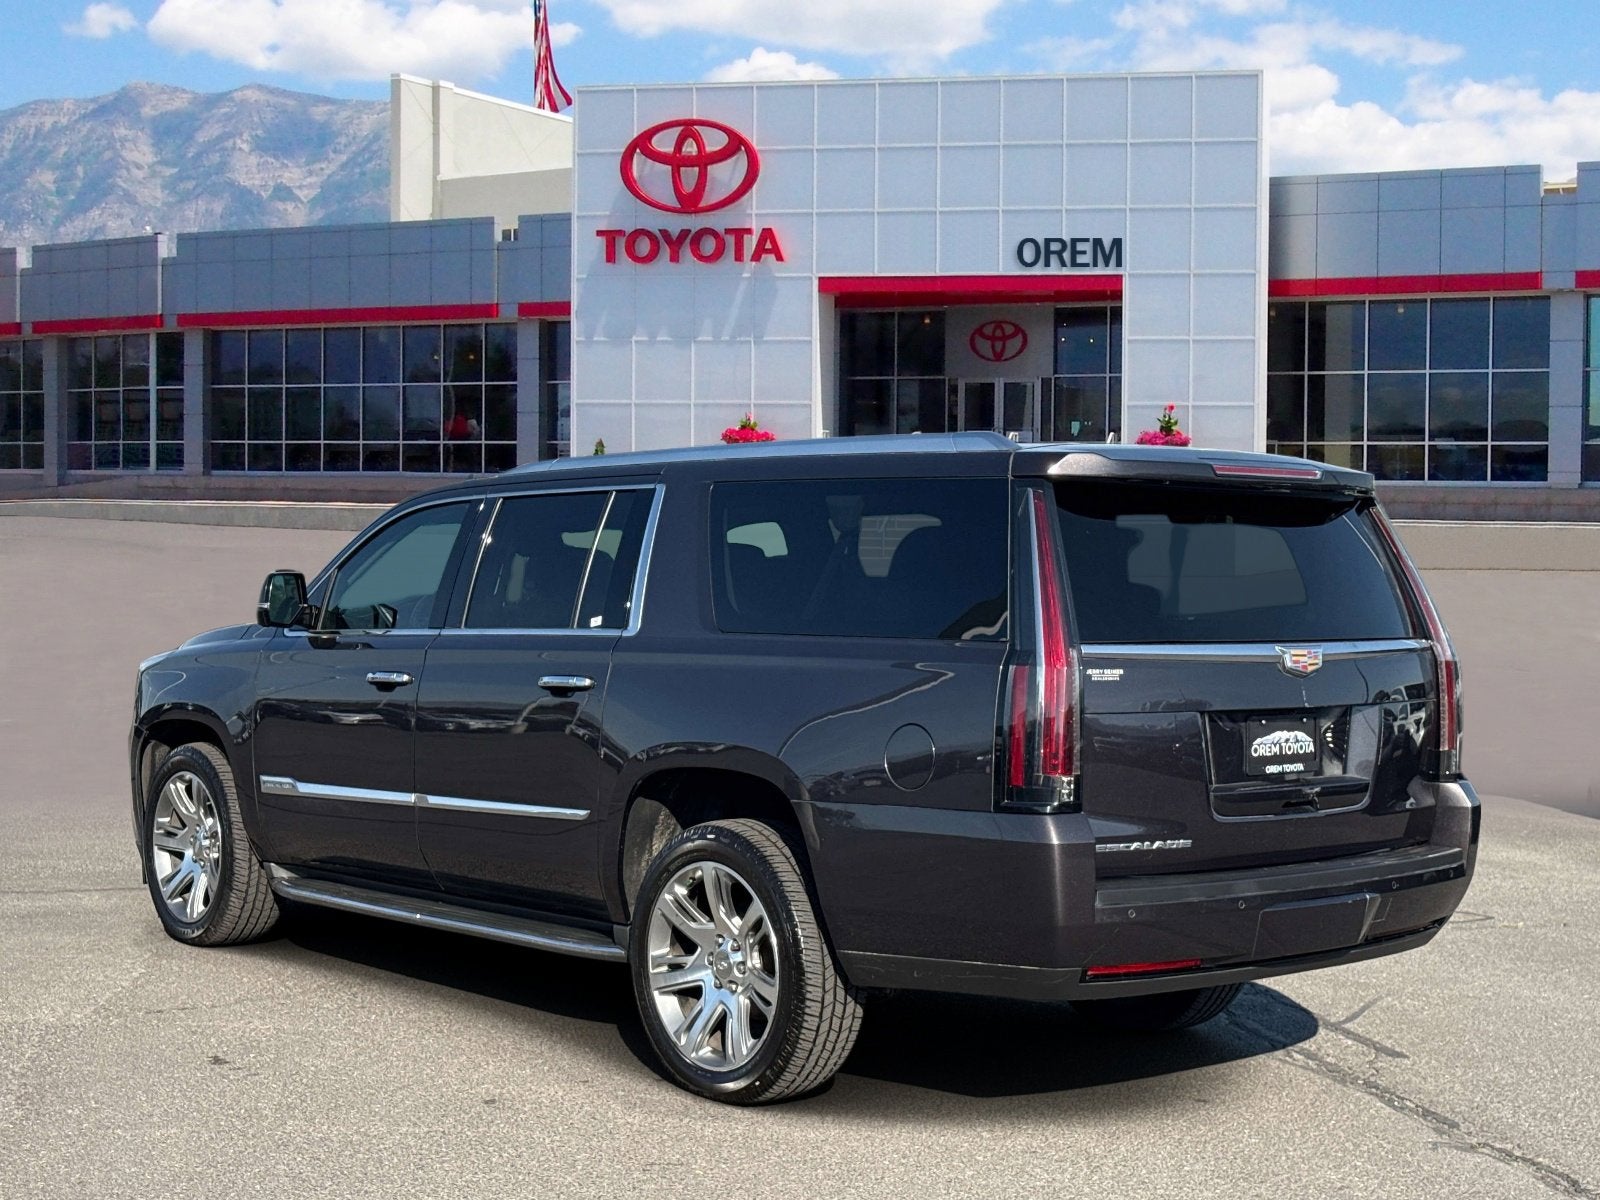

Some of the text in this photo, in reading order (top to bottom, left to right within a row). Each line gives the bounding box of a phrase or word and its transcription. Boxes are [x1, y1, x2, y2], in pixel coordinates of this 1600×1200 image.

[596, 227, 785, 264] TOYOTA
[1017, 237, 1123, 268] OREM
[1251, 741, 1315, 757] OREM TOYOTA
[1265, 763, 1304, 774] OREM TOYOTA
[1095, 839, 1193, 853] ESCALADE
